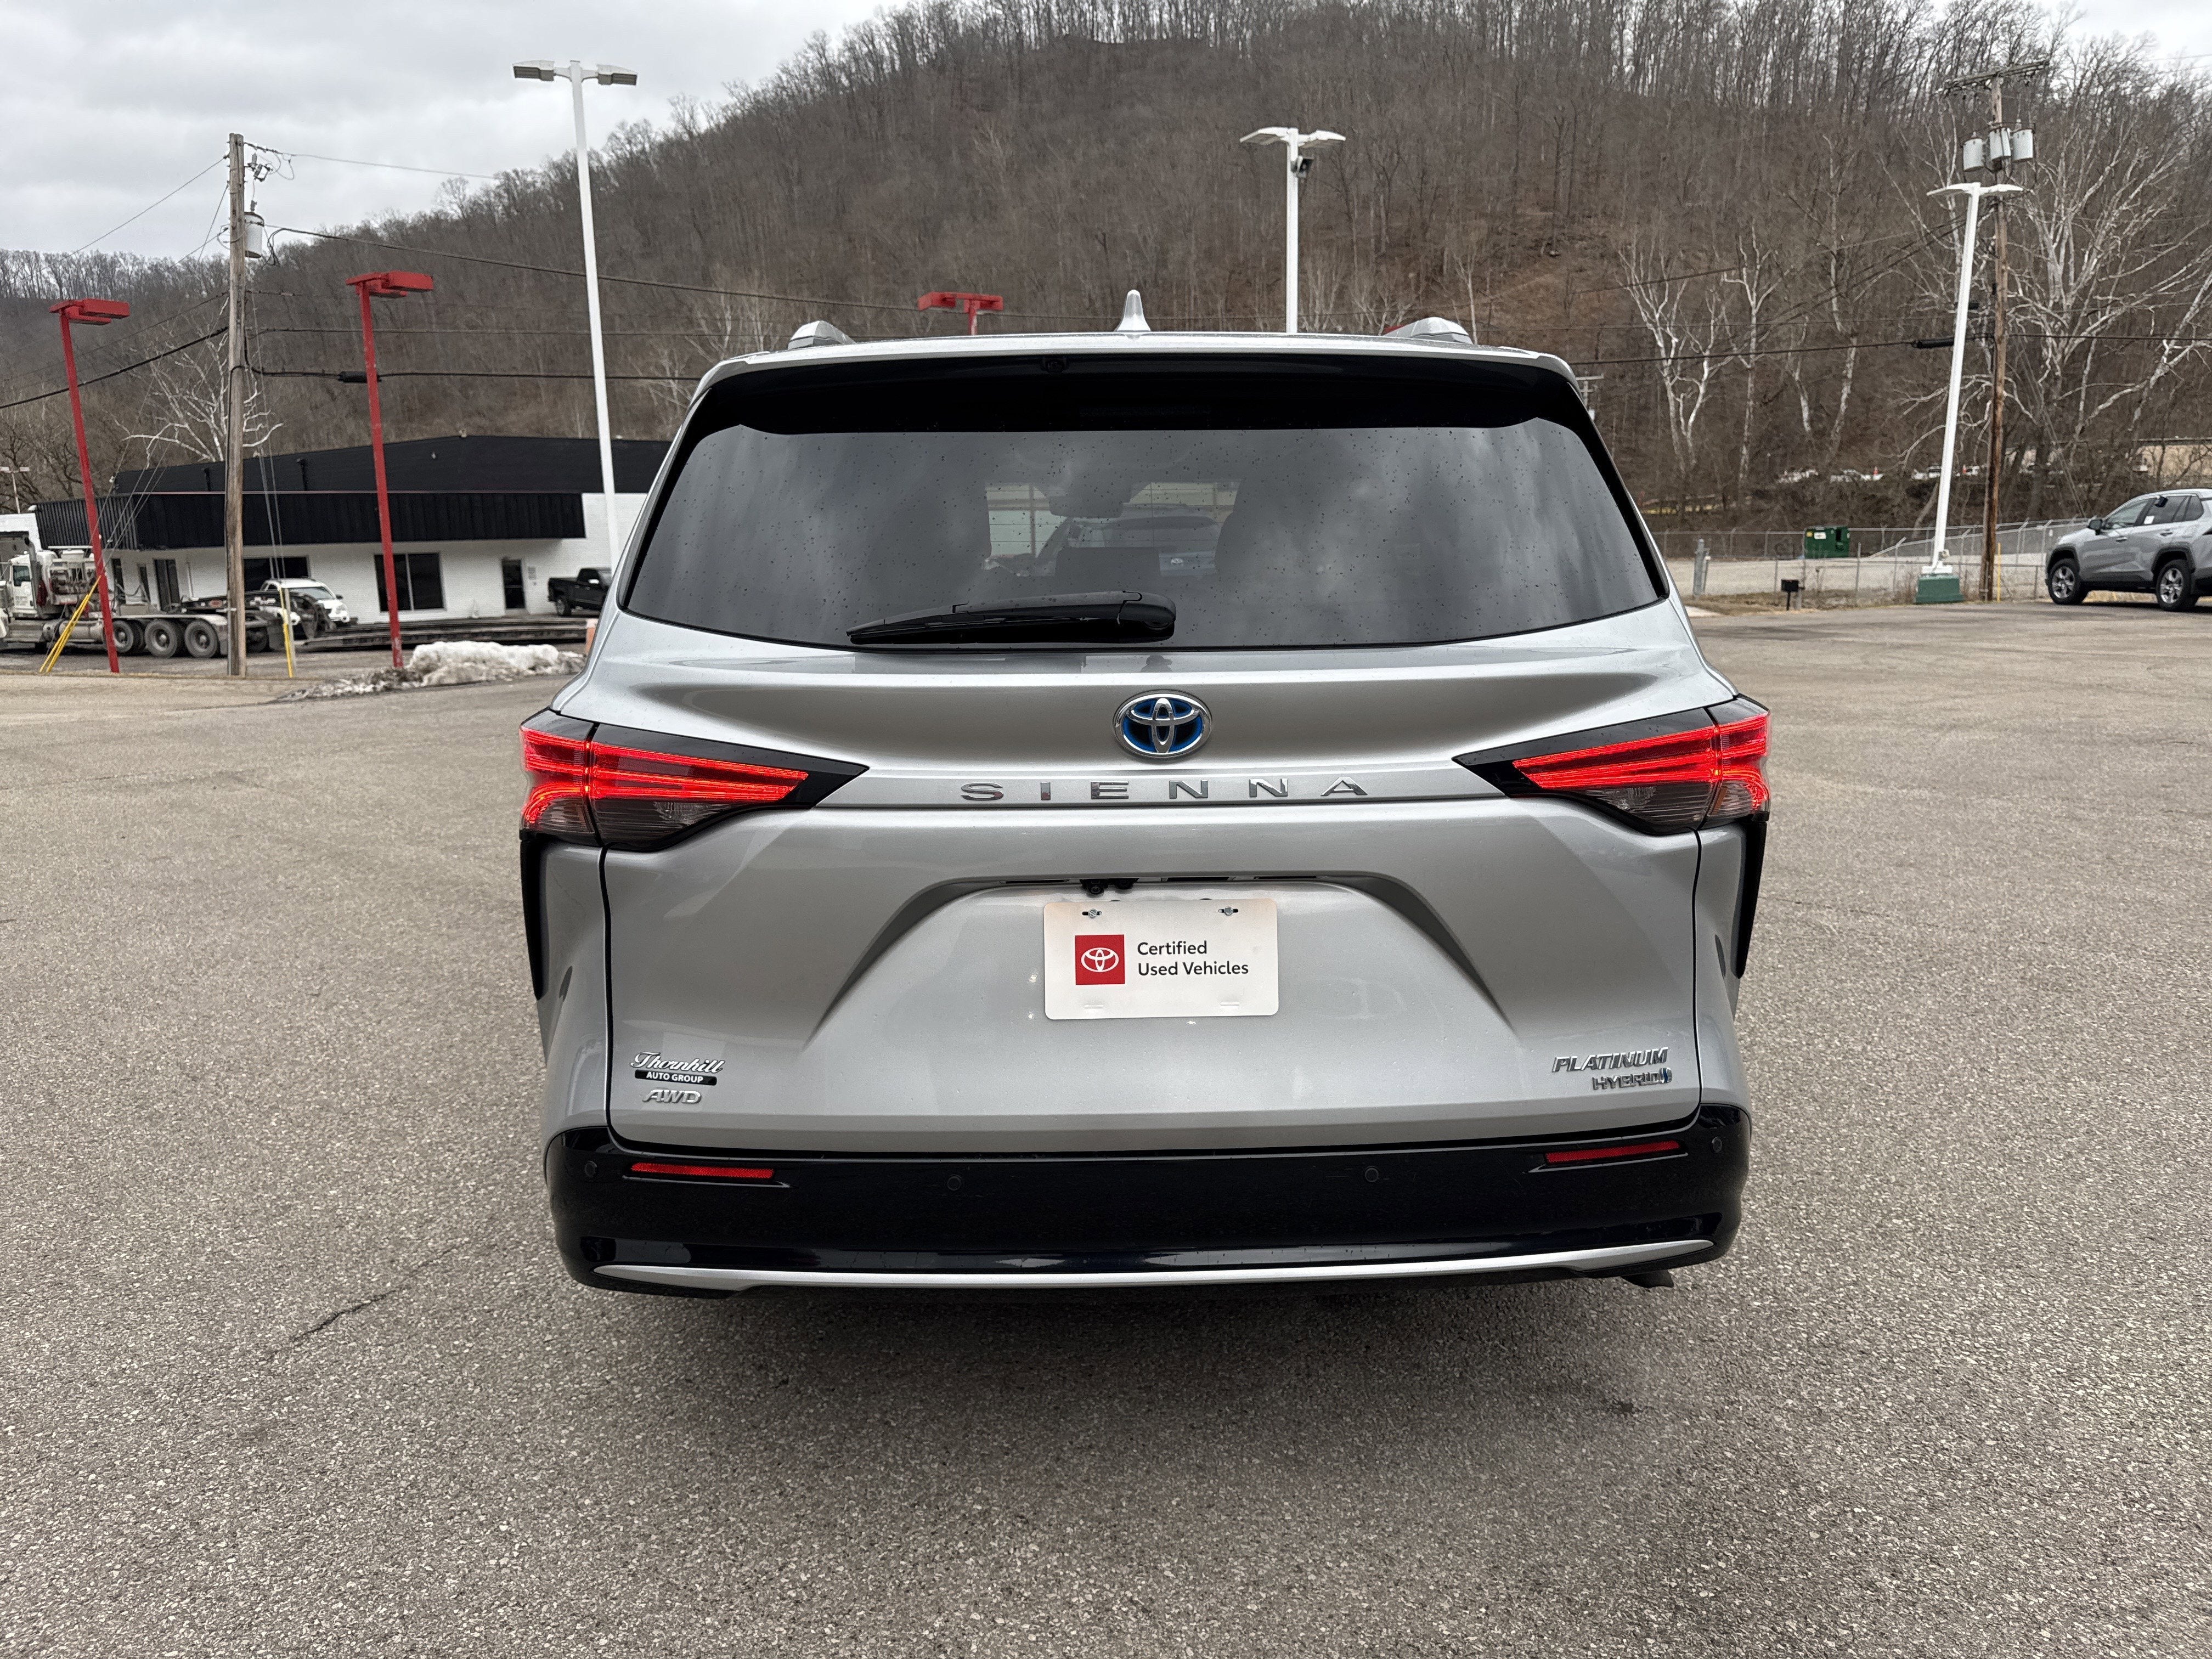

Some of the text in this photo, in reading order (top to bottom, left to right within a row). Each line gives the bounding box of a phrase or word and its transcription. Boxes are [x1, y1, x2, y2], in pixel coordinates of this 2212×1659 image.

[961, 776, 1368, 801] SIENNA
[1137, 940, 1207, 955] Certified
[1138, 961, 1249, 976] Used Vehicles
[631, 1052, 725, 1074] Thornhill
[1552, 1047, 1668, 1073] PLATINUM
[646, 1071, 704, 1084] AUTO GROUP
[1592, 1072, 1662, 1091] HYBRID
[642, 1089, 702, 1104] AWD
